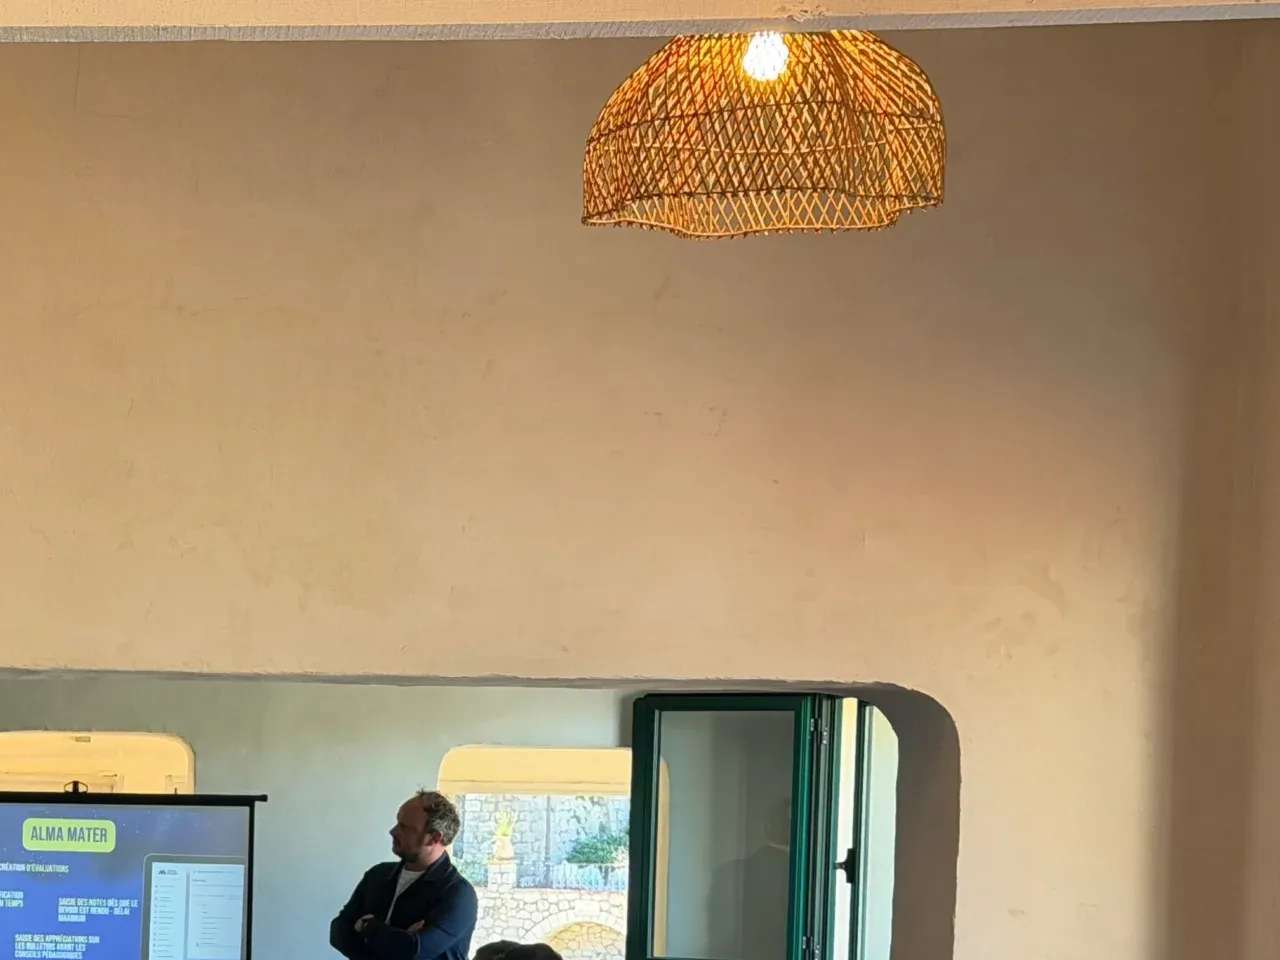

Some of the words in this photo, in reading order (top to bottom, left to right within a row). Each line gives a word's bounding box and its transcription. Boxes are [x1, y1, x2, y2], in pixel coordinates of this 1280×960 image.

[31, 826, 64, 841] ALMA
[67, 826, 108, 843] MATER
[5, 899, 24, 907] TEMPS
[58, 897, 77, 906] SAISIE
[77, 898, 89, 906] DES
[88, 898, 107, 907] NOTES
[119, 899, 131, 908] QUE
[131, 900, 139, 908] LE
[58, 906, 78, 914] DEVOIR
[78, 906, 90, 915] EST
[90, 907, 110, 915] RENDU
[113, 907, 131, 915] DÉLAI
[14, 934, 33, 942] SAISIE
[33, 935, 45, 943] DES
[45, 934, 88, 943] APPRÉCIATIONS
[88, 936, 100, 944] SUR
[14, 942, 26, 950] LES
[26, 942, 56, 951] BULLETINS
[56, 943, 76, 951] AVANT
[75, 944, 87, 952] LES
[14, 951, 42, 959] CONSEILS
[42, 950, 83, 960] PÉDAGOGIQUES
